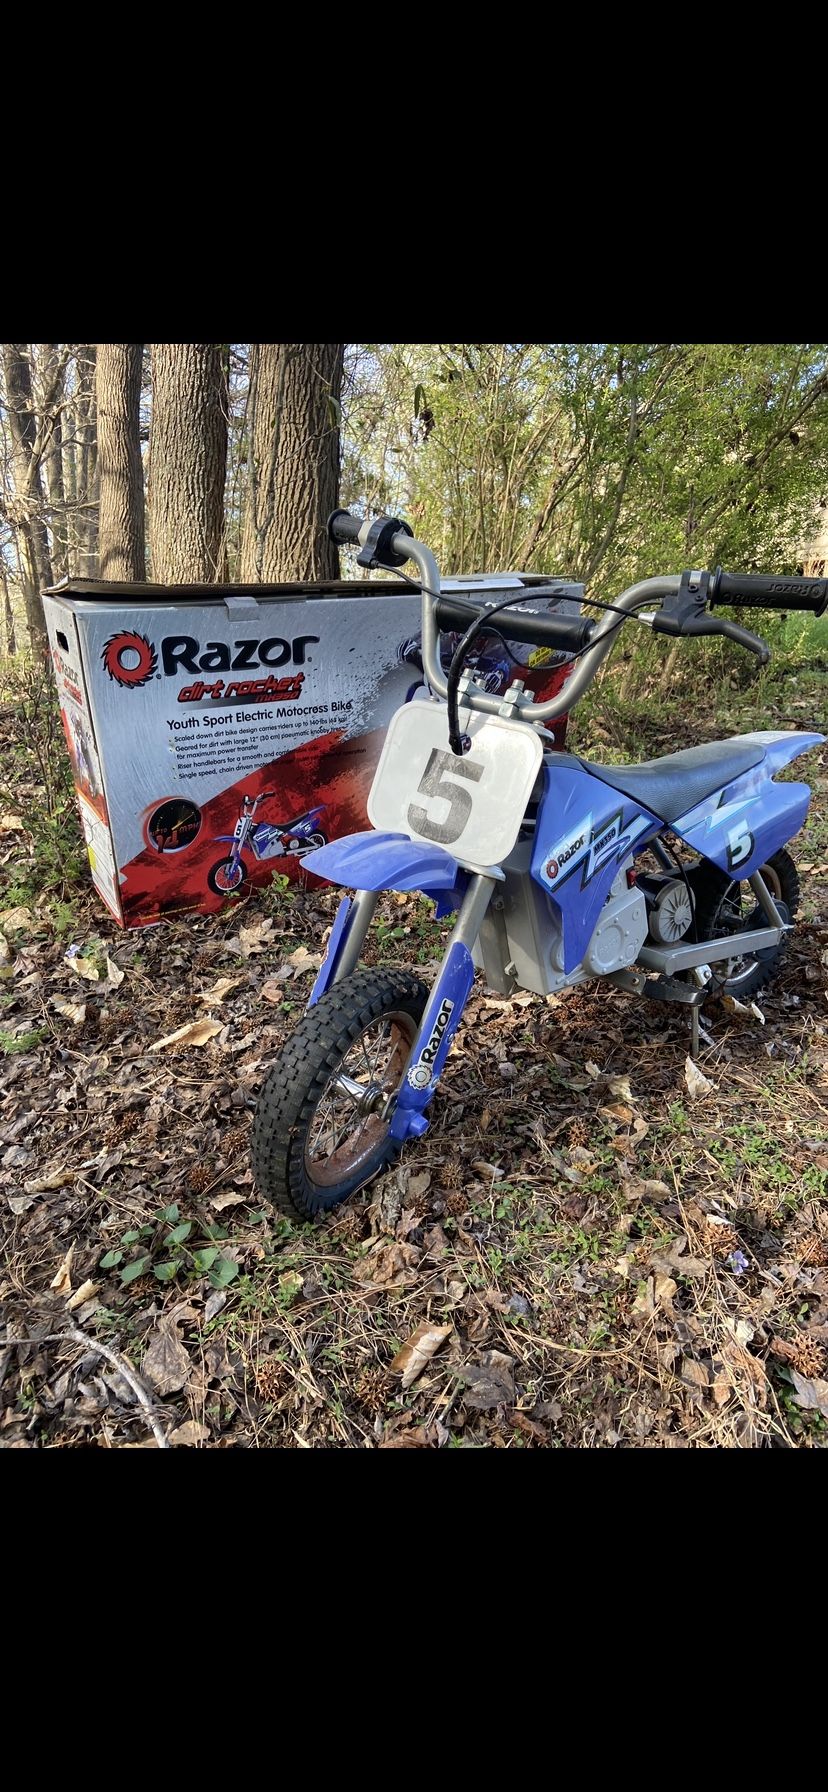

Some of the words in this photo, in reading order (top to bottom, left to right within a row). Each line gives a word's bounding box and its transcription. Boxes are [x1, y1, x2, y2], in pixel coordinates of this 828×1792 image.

[161, 635, 320, 677] Razor
[177, 679, 225, 703] dirt
[224, 671, 305, 698] rocket
[166, 716, 200, 730] Youth
[203, 713, 233, 728] Sport
[236, 709, 273, 722] Electric
[276, 704, 328, 718] Motocross
[331, 700, 352, 712] Bike
[174, 735, 195, 743] Scaled
[196, 732, 213, 740] down
[225, 728, 238, 736] bike
[238, 727, 257, 736] design
[175, 744, 198, 752] Geared
[233, 737, 249, 746] large
[177, 761, 192, 769] Riser
[193, 756, 226, 768] handlebars
[241, 752, 262, 761] smooth
[186, 750, 217, 759] maximum
[217, 747, 236, 756] power
[237, 744, 259, 753] transfer
[178, 771, 198, 780] Single
[218, 765, 235, 774] chain
[235, 762, 253, 771] driven
[407, 747, 486, 845] 5
[557, 833, 585, 868] Razor
[726, 818, 755, 873] 5
[420, 999, 452, 1065] Razor
